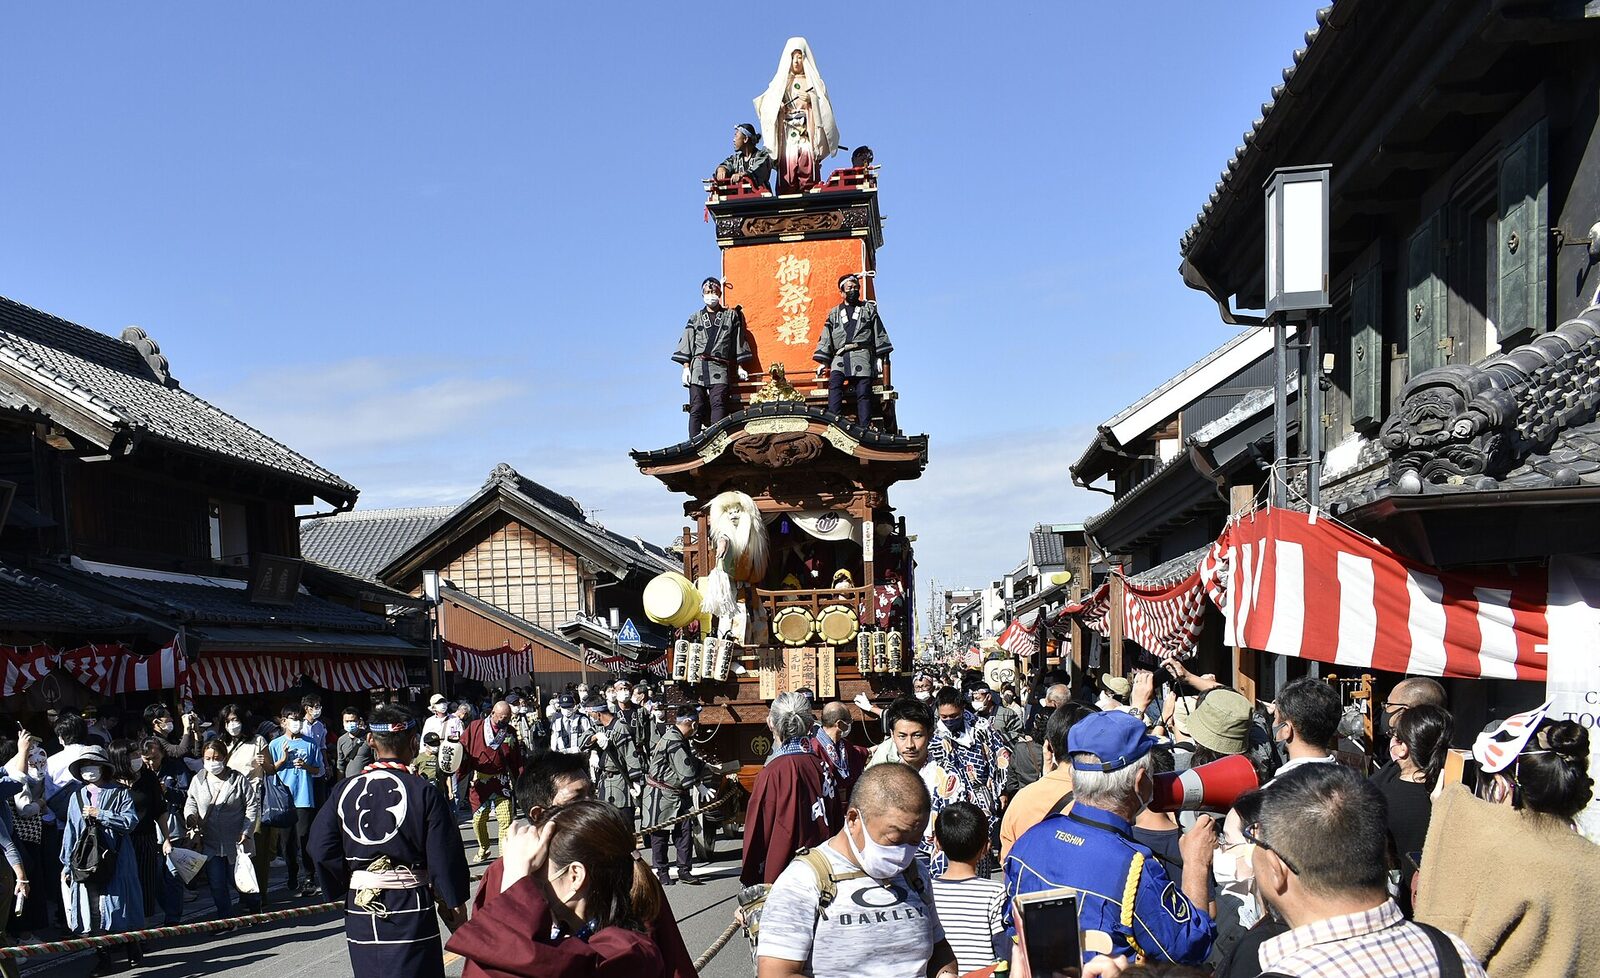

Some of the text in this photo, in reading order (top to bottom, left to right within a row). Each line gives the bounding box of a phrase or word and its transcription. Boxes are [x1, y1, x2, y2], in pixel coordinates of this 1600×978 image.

[775, 254, 813, 345] 御祭禮
[1585, 691, 1600, 704] C
[1054, 830, 1086, 846] TEISHIN
[840, 907, 924, 925] OAKLEY
